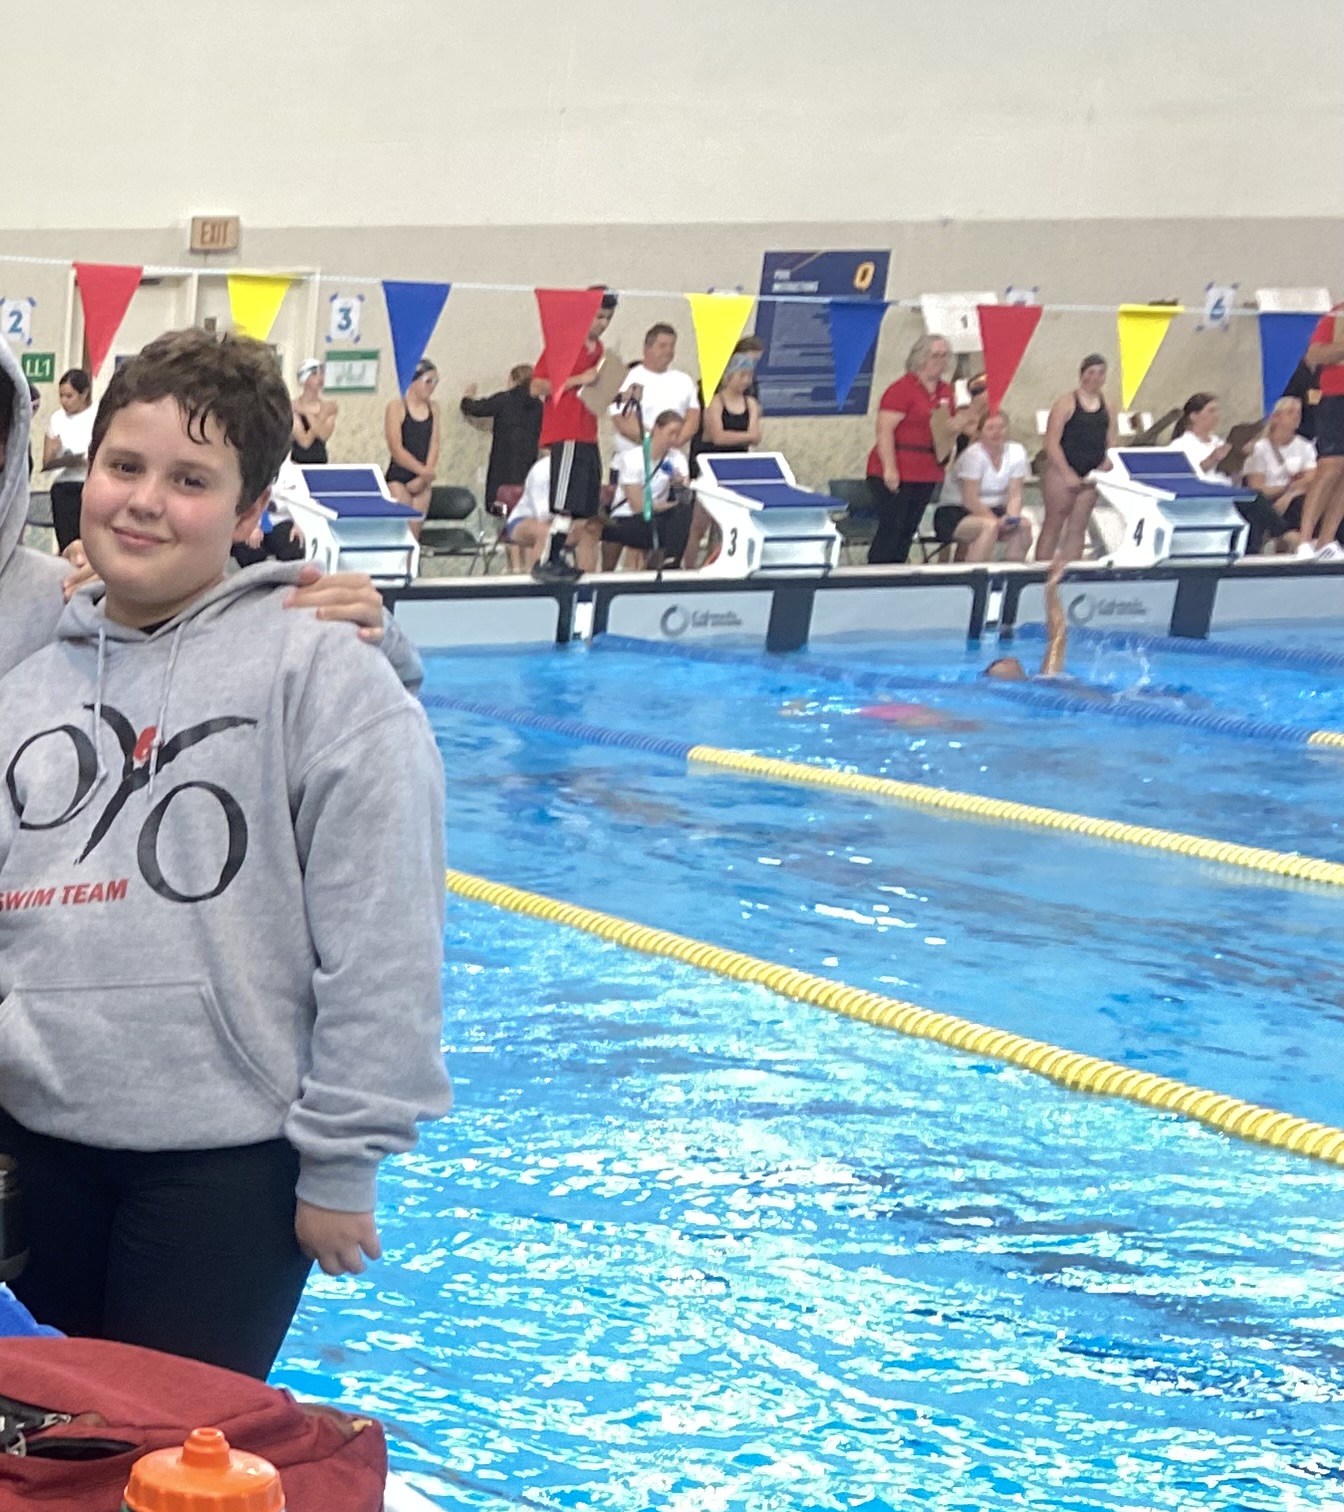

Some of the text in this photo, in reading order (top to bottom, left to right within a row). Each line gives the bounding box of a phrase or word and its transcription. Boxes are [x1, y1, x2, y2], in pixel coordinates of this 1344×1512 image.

[201, 220, 229, 246] EXIT
[8, 310, 23, 333] 2
[337, 306, 352, 331] 3
[1210, 297, 1226, 321] 6
[728, 527, 738, 557] 3
[1133, 518, 1145, 547] 4
[62, 879, 129, 905] TEAM
